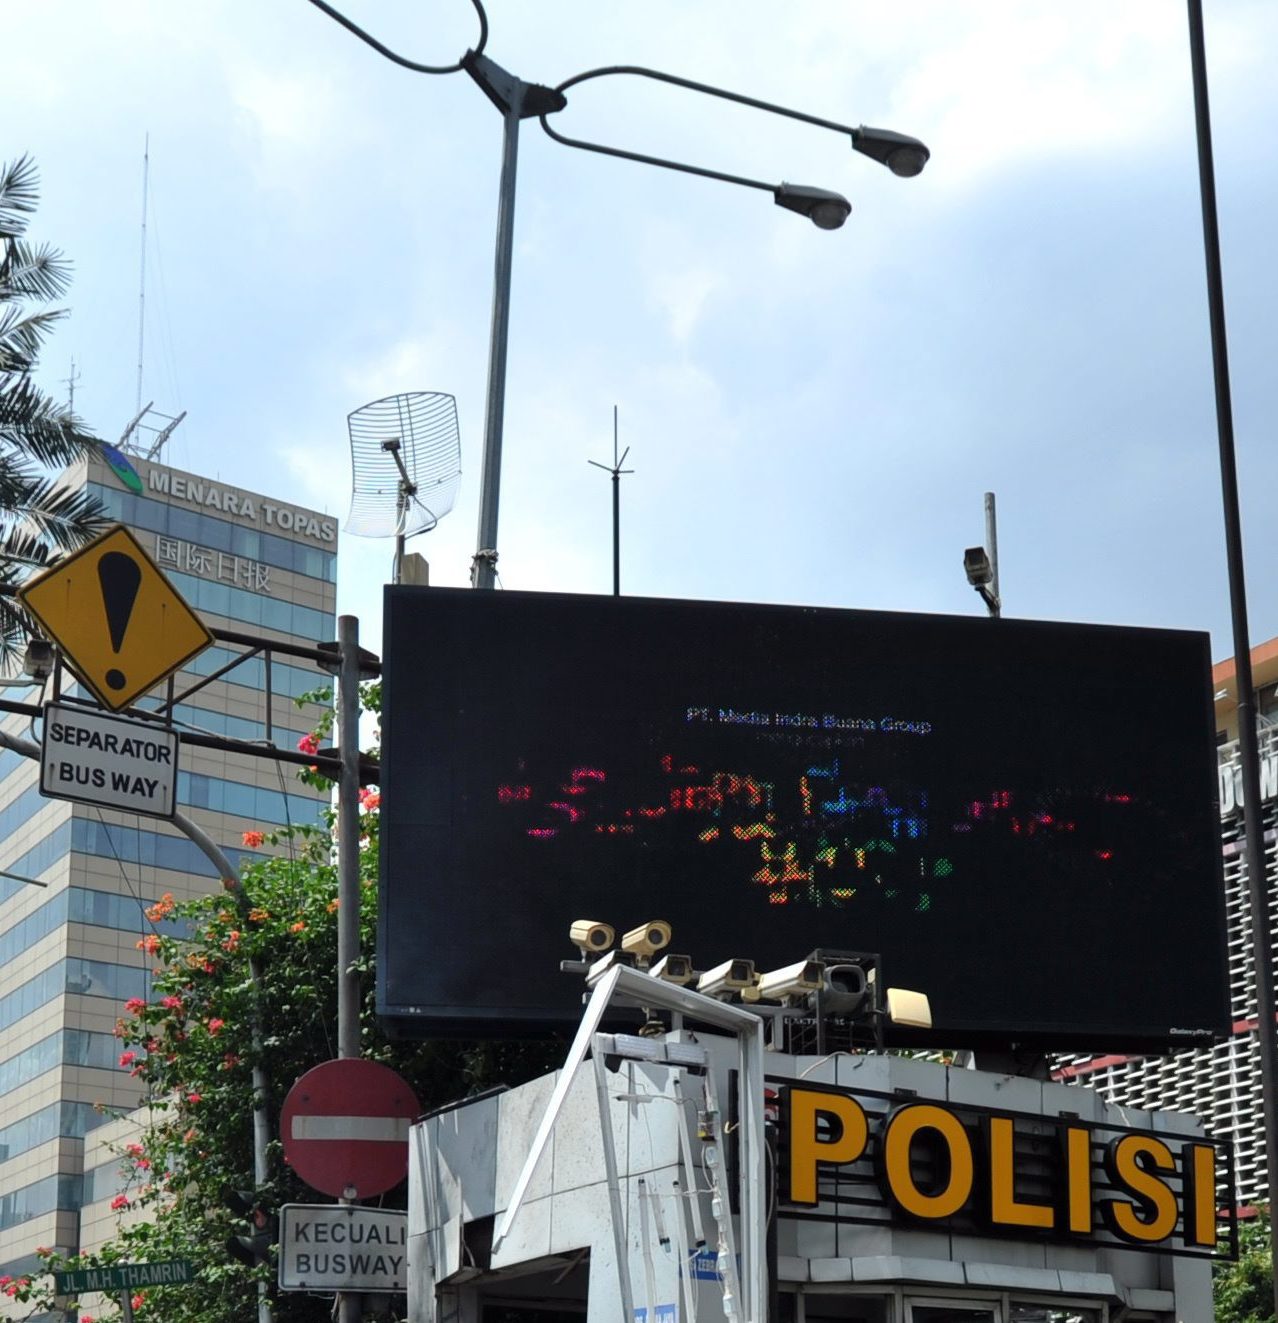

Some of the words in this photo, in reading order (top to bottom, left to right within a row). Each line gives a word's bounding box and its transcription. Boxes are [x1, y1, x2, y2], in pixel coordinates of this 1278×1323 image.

[149, 469, 256, 520] MENARA
[263, 503, 335, 542] TOPAS
[156, 534, 272, 592] 国际日报
[719, 708, 770, 725] Media
[775, 711, 819, 728] Indra
[823, 714, 876, 730] Buana
[880, 716, 931, 734] Group
[49, 721, 172, 765] SEPARATOR
[790, 1088, 1217, 1249] POLISI
[294, 1222, 405, 1246] KECUALI
[63, 1274, 83, 1292] JL.
[86, 1270, 116, 1289] M.H.
[119, 1263, 187, 1287] THAMRIN
[296, 1253, 403, 1276] BUSWAY
